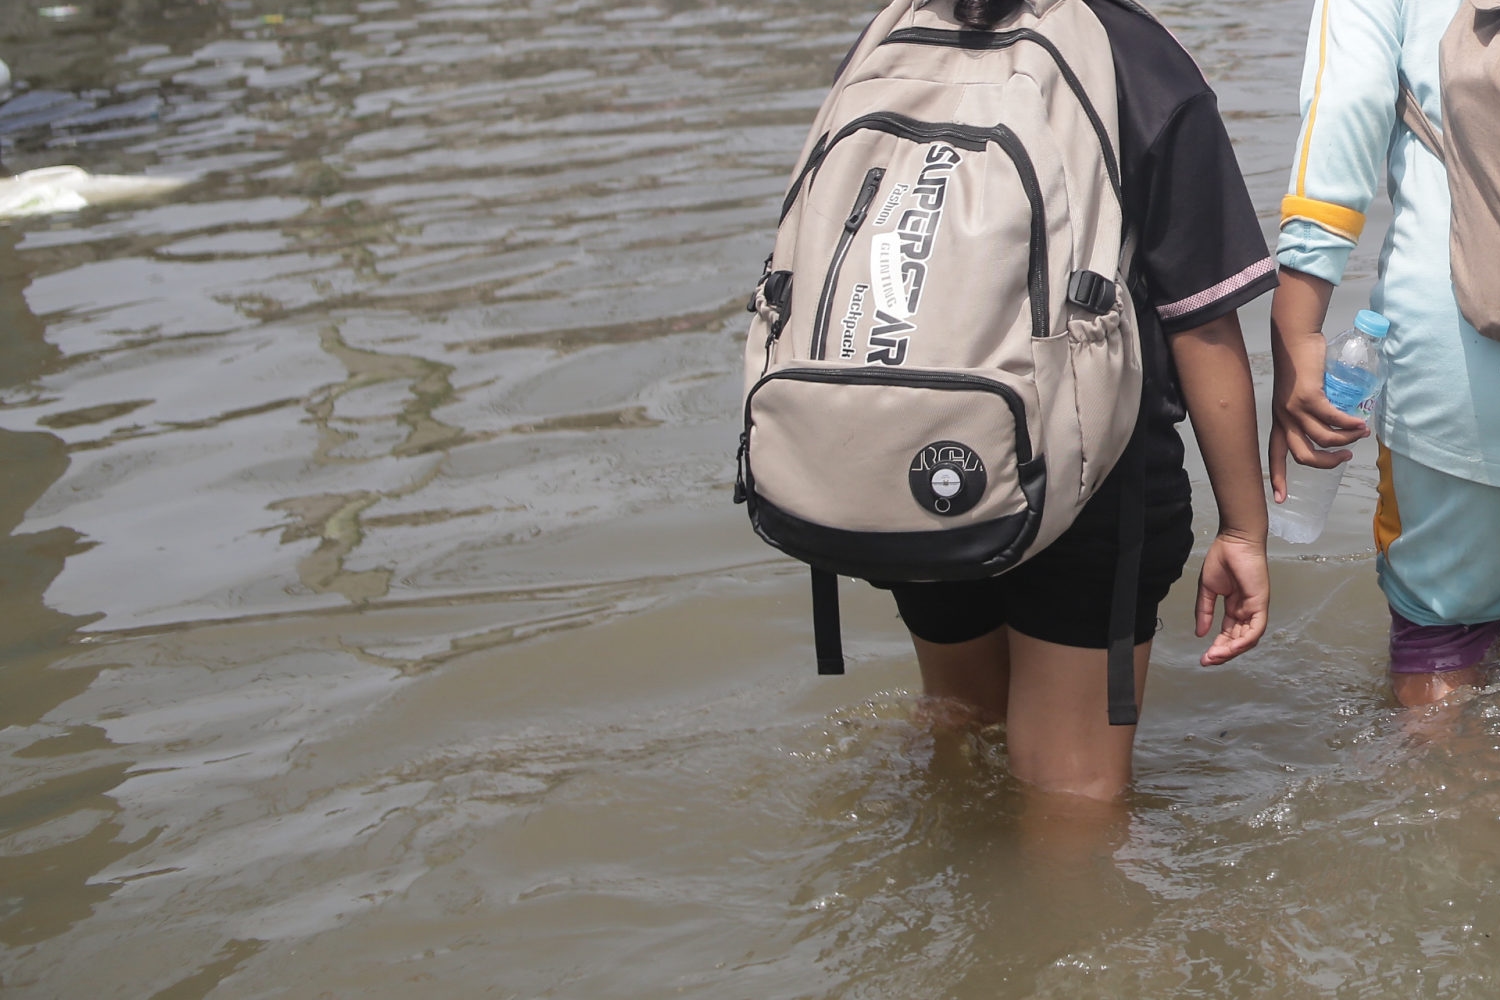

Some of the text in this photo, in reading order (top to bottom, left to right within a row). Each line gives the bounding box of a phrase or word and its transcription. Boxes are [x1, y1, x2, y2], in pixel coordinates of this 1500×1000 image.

[874, 183, 909, 227] fashion
[879, 241, 898, 309] GLINTING
[841, 283, 869, 360] backpack
